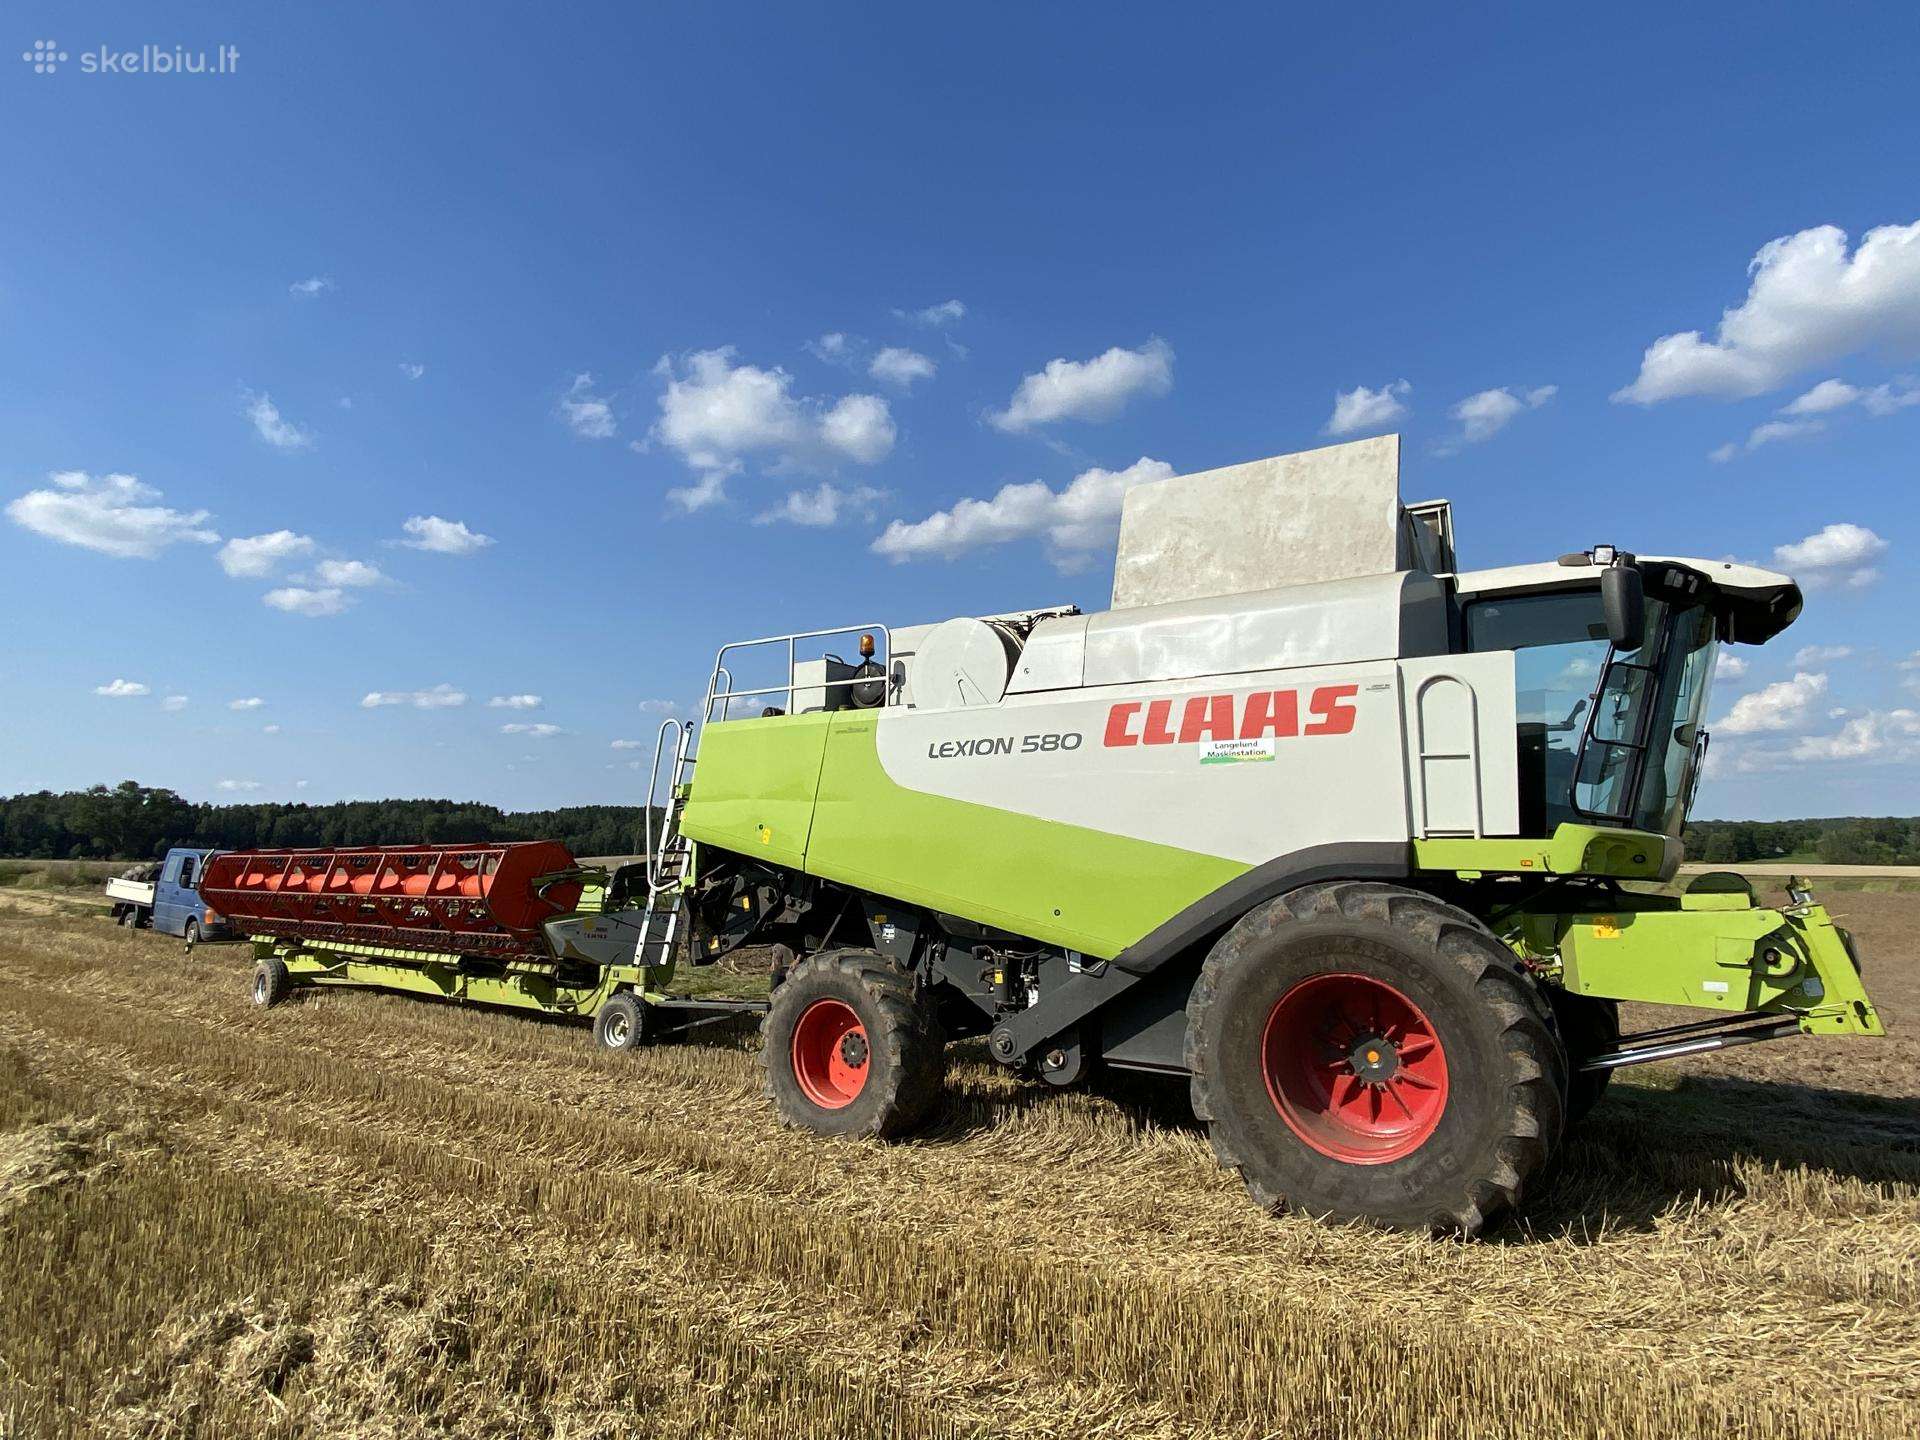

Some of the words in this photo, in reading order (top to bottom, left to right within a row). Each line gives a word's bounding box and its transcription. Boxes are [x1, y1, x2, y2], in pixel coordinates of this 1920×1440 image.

[1103, 684, 1359, 748] CLAAS
[928, 736, 1015, 759] LEXION
[1020, 732, 1083, 754] 580
[1207, 749, 1267, 758] Maskinstation
[1214, 740, 1258, 750] Langelund
